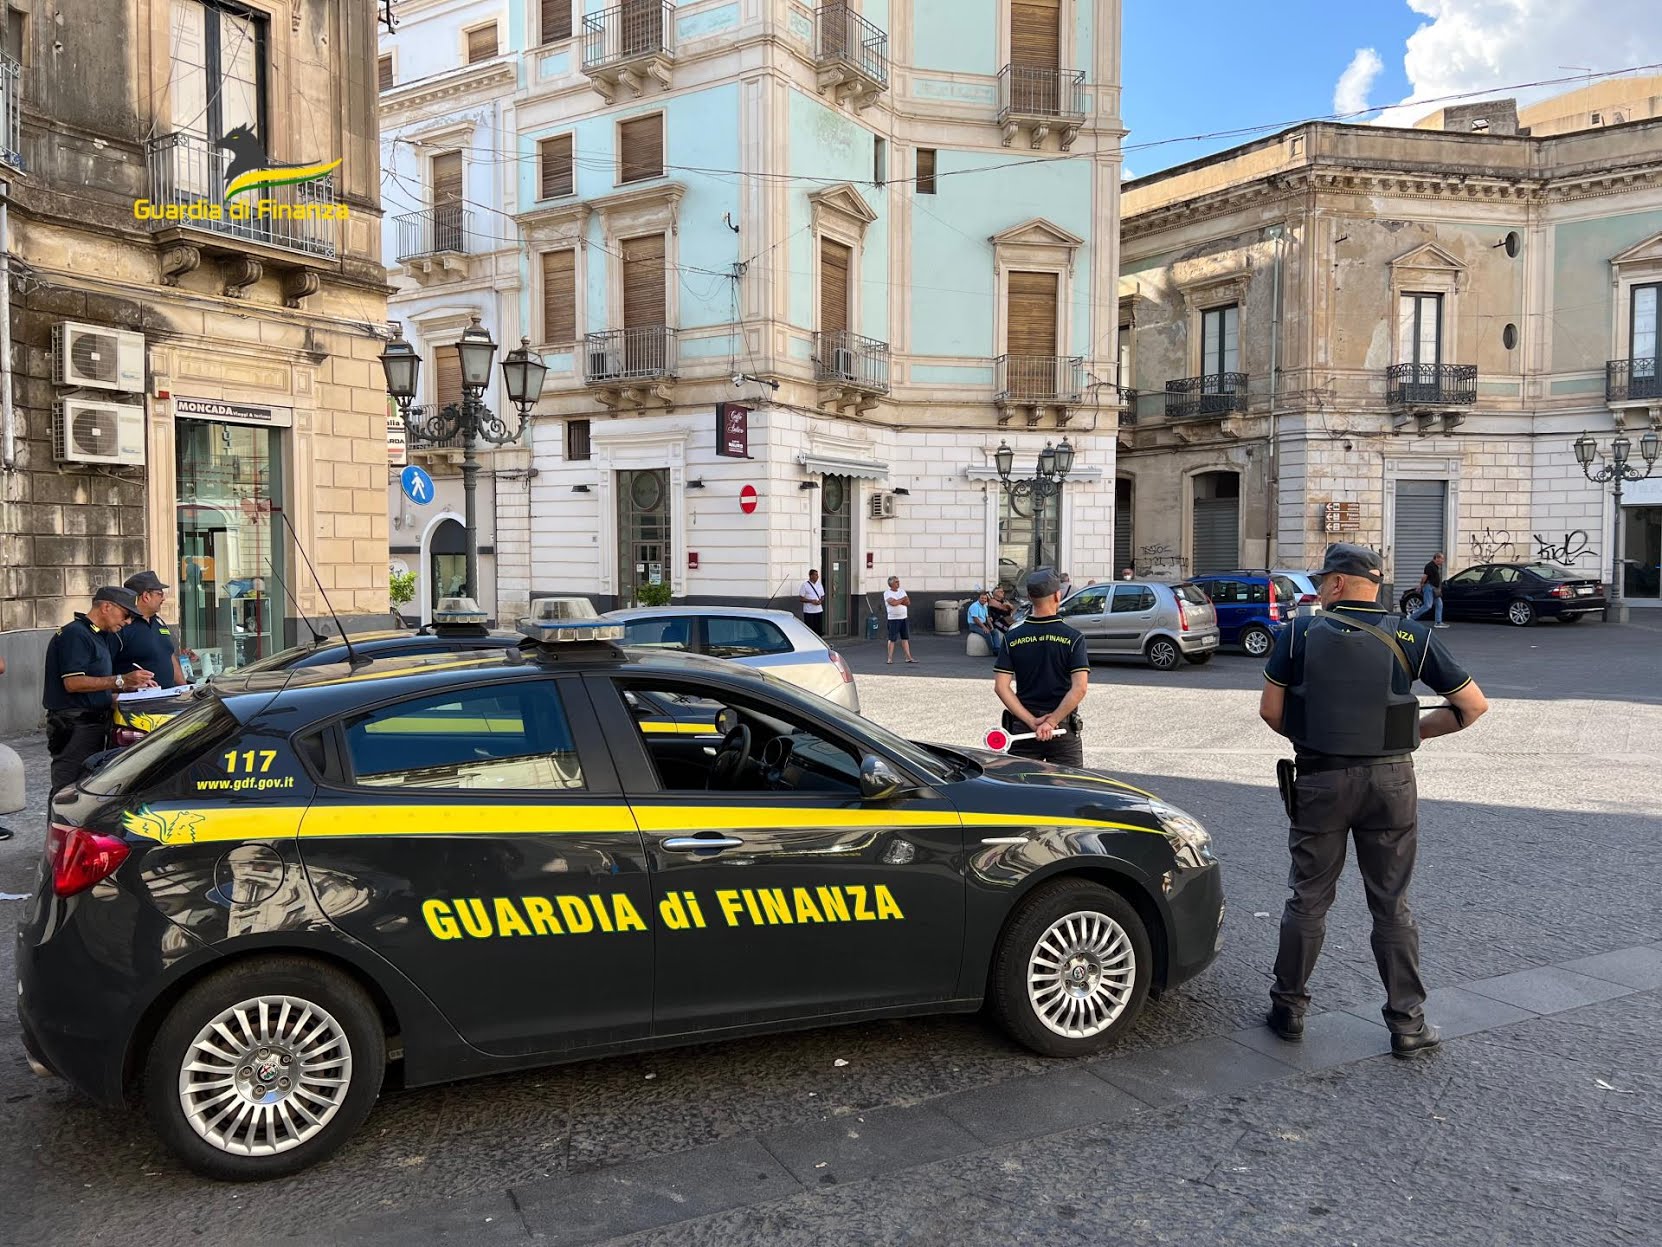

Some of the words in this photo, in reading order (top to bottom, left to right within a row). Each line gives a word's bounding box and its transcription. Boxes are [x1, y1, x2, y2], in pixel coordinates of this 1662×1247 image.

[178, 401, 233, 416] MONCADA
[1009, 635, 1037, 647] GUARDIA
[1045, 633, 1072, 646] FINANZA
[224, 750, 277, 773] 117
[196, 776, 294, 791] www.gdf.gov.it
[421, 894, 648, 940] GUARDIA
[659, 891, 706, 929] di
[716, 884, 905, 926] FINANZA
